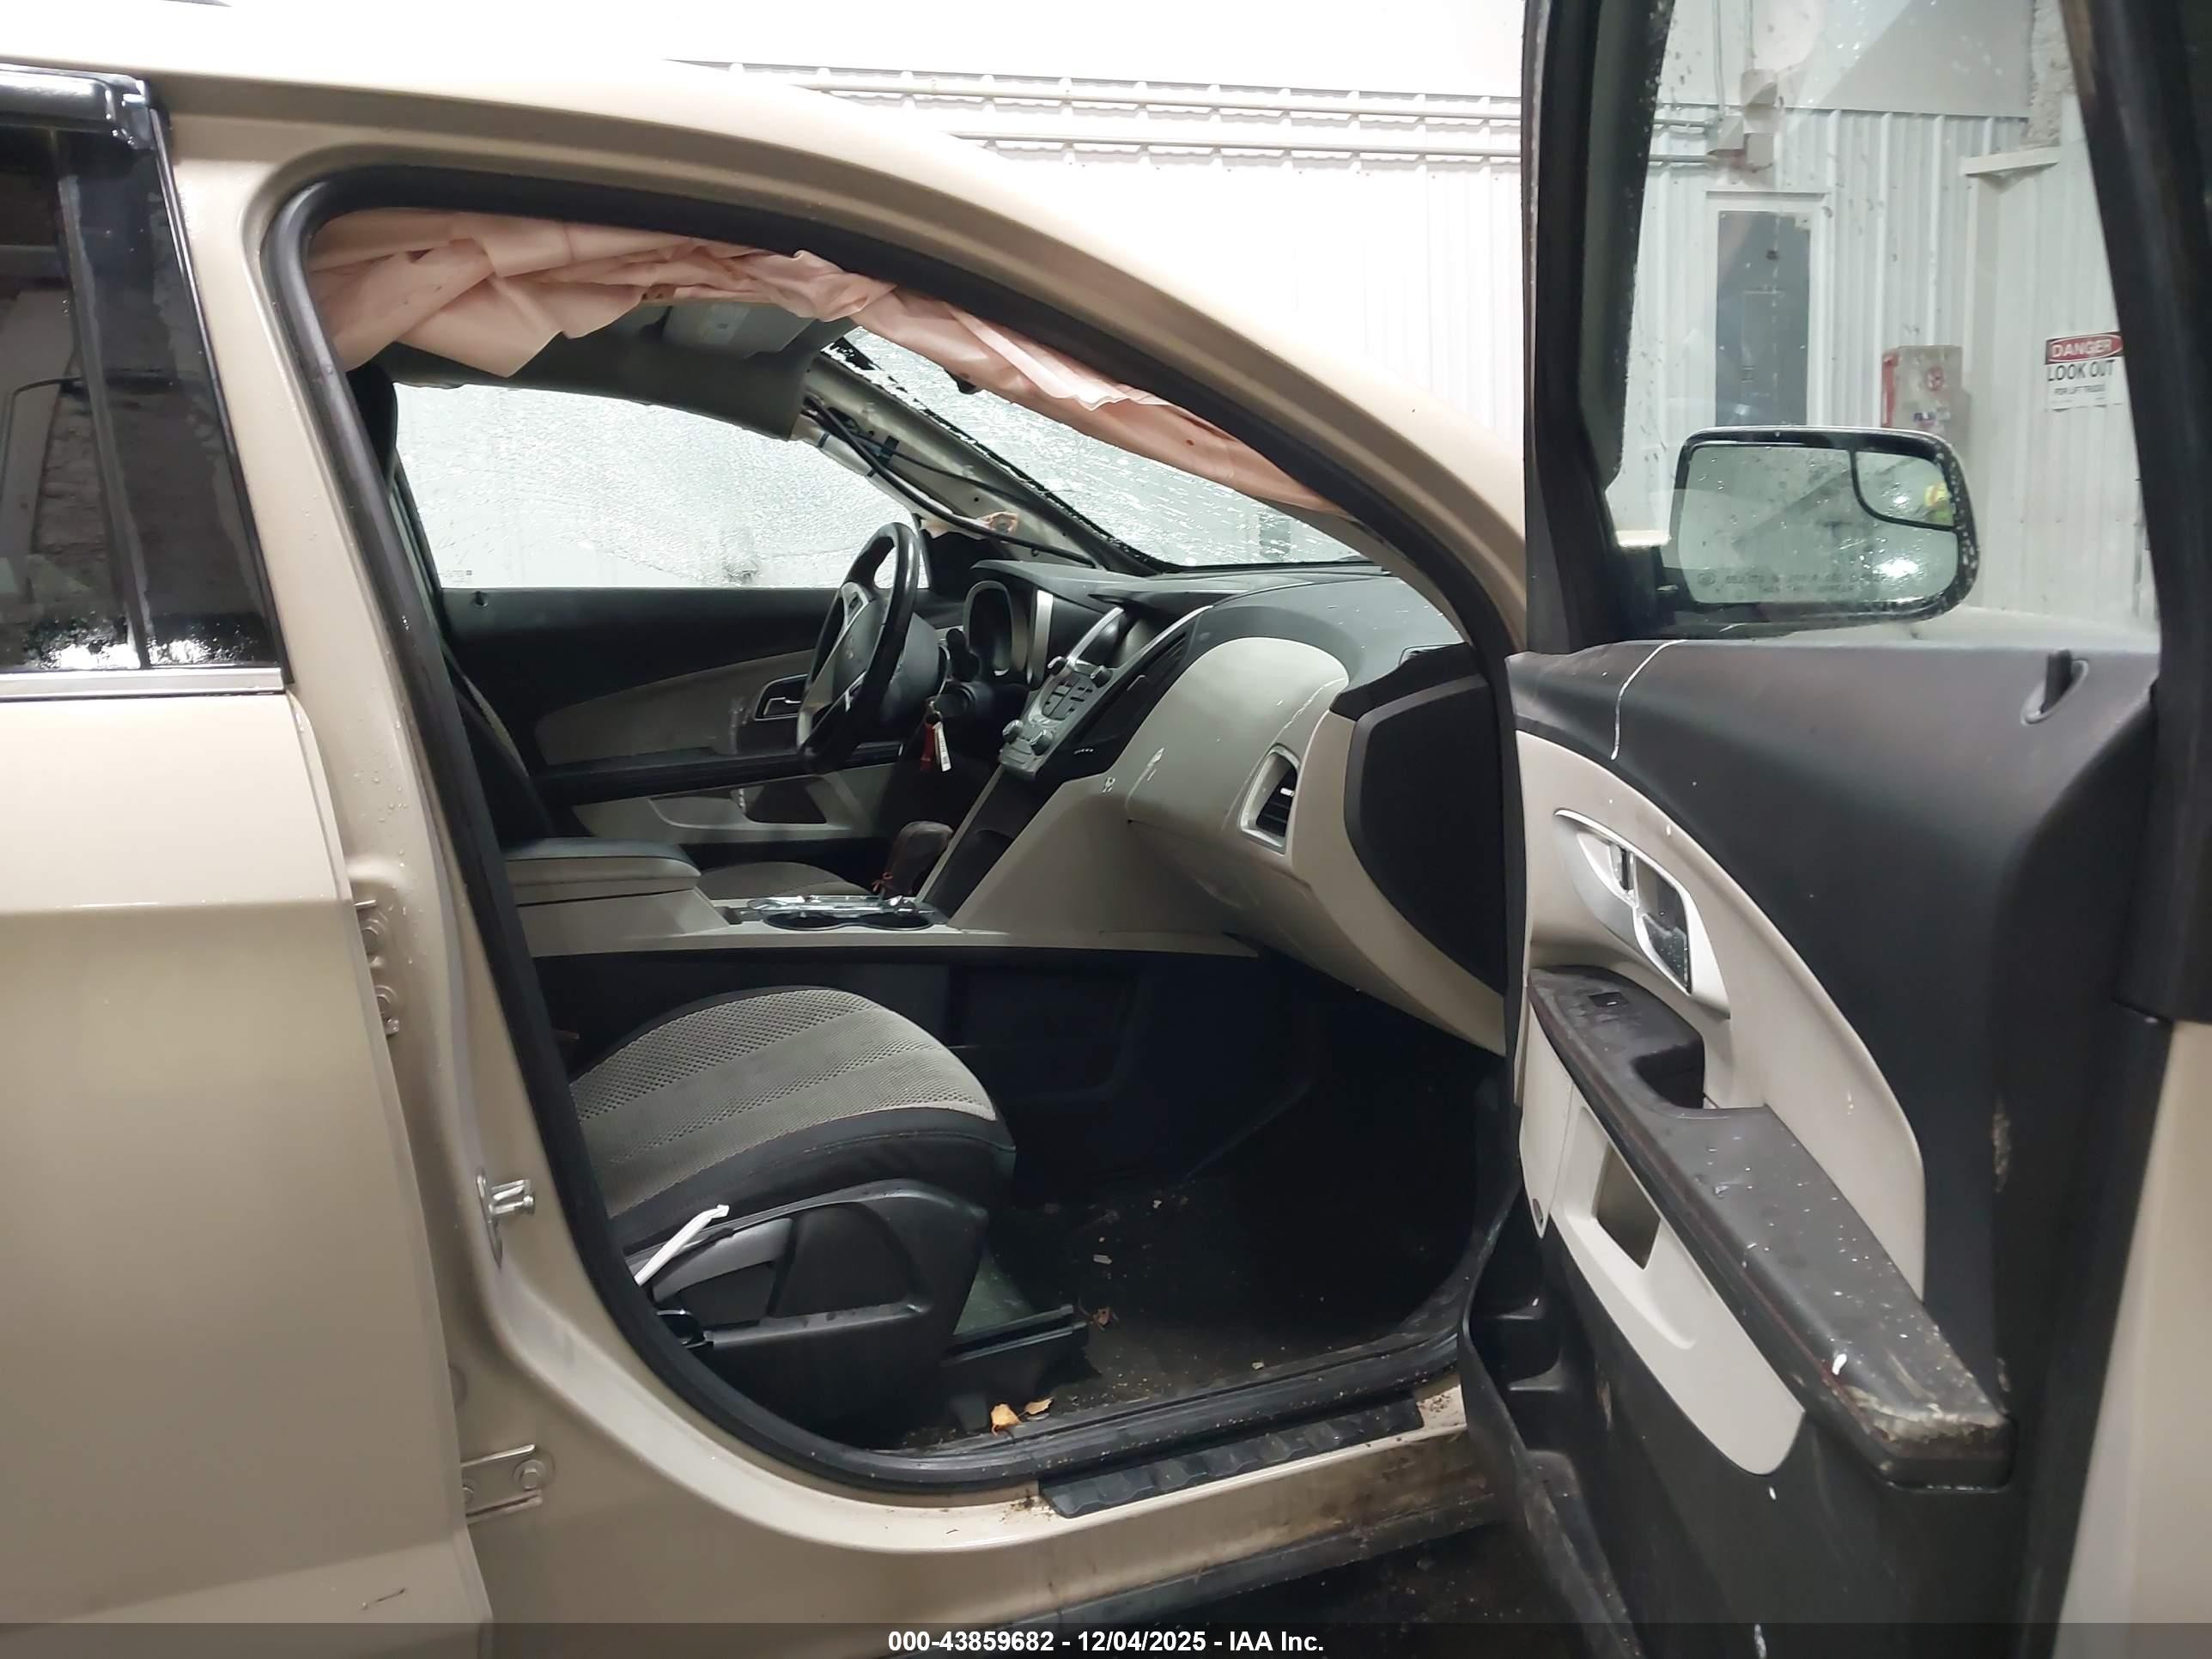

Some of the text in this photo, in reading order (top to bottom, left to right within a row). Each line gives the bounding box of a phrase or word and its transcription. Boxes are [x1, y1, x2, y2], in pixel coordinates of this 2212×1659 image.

[2051, 338, 2112, 358] DANGER
[2047, 359, 2116, 381] LOOK OUT
